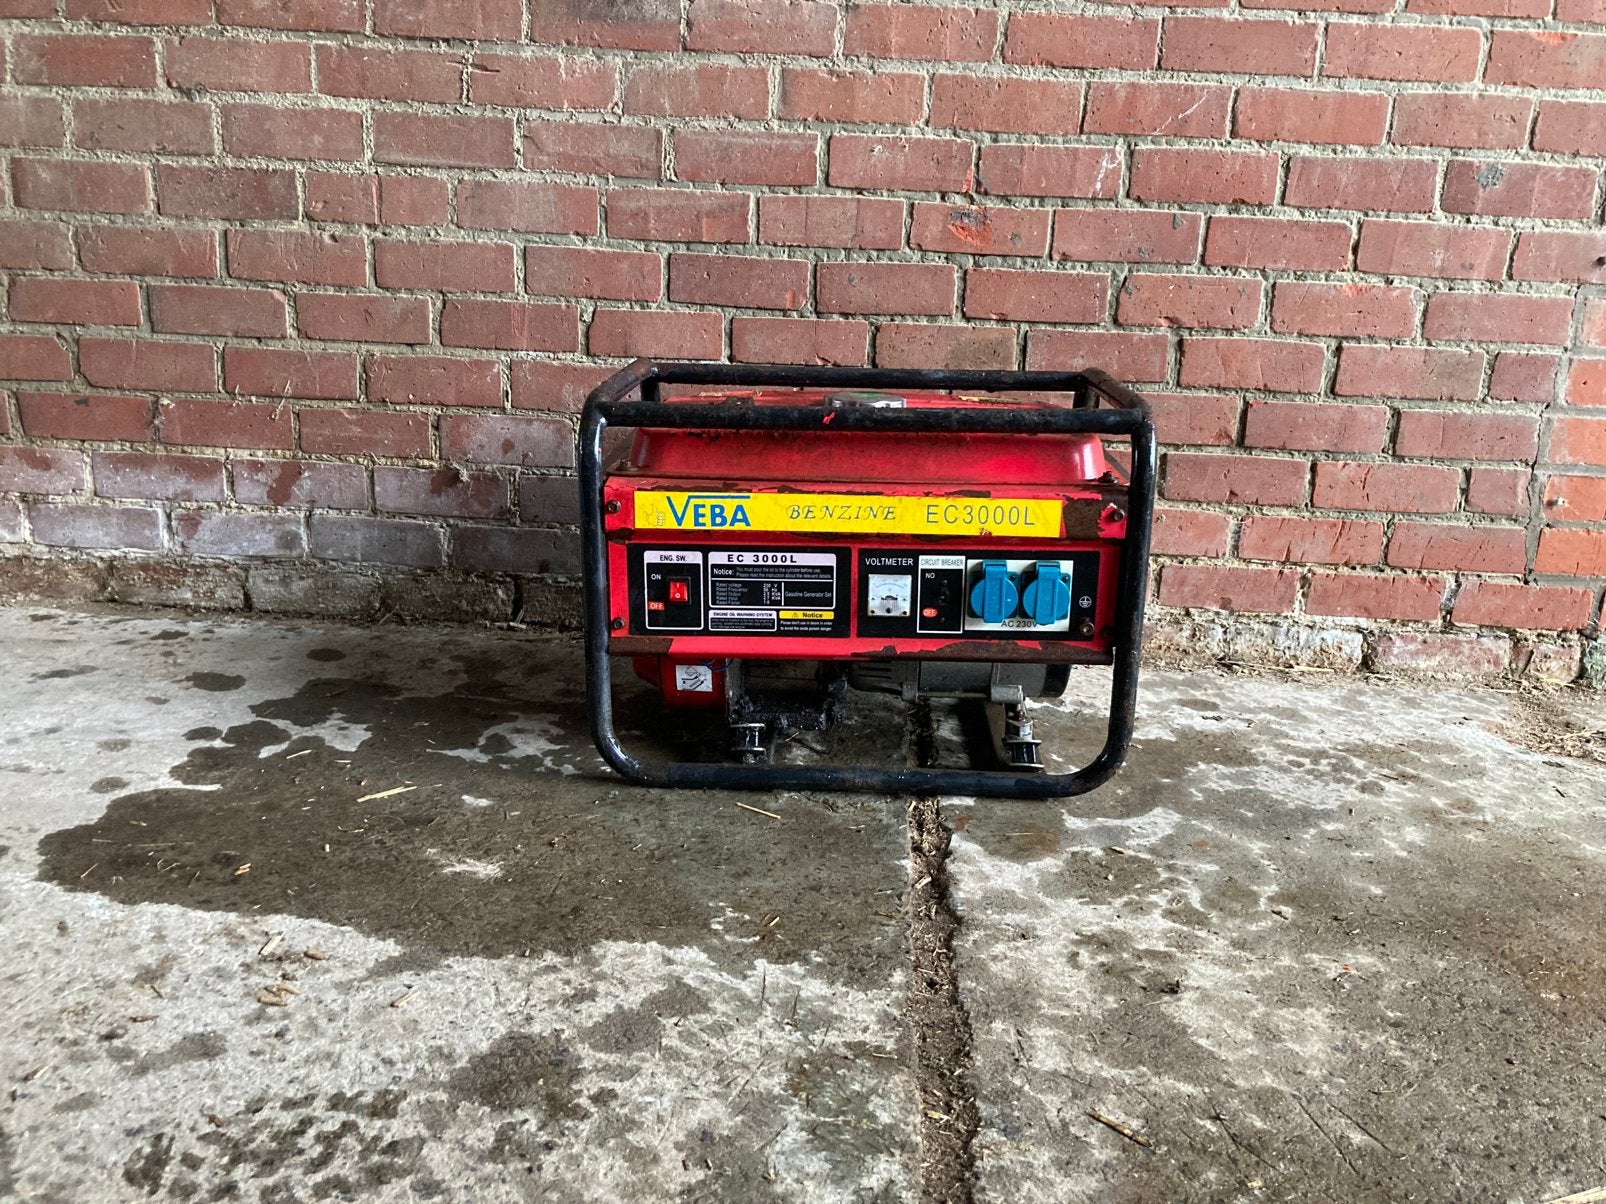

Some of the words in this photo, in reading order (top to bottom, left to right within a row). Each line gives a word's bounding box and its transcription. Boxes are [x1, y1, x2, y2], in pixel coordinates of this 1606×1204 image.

[666, 495, 751, 527] VEBA
[786, 504, 897, 520] BENZINE
[926, 504, 1035, 526] EC3000L
[727, 554, 744, 562] EC
[752, 554, 797, 564] 3000L
[864, 558, 914, 566] VOLTMETER
[942, 558, 964, 566] BREAKER
